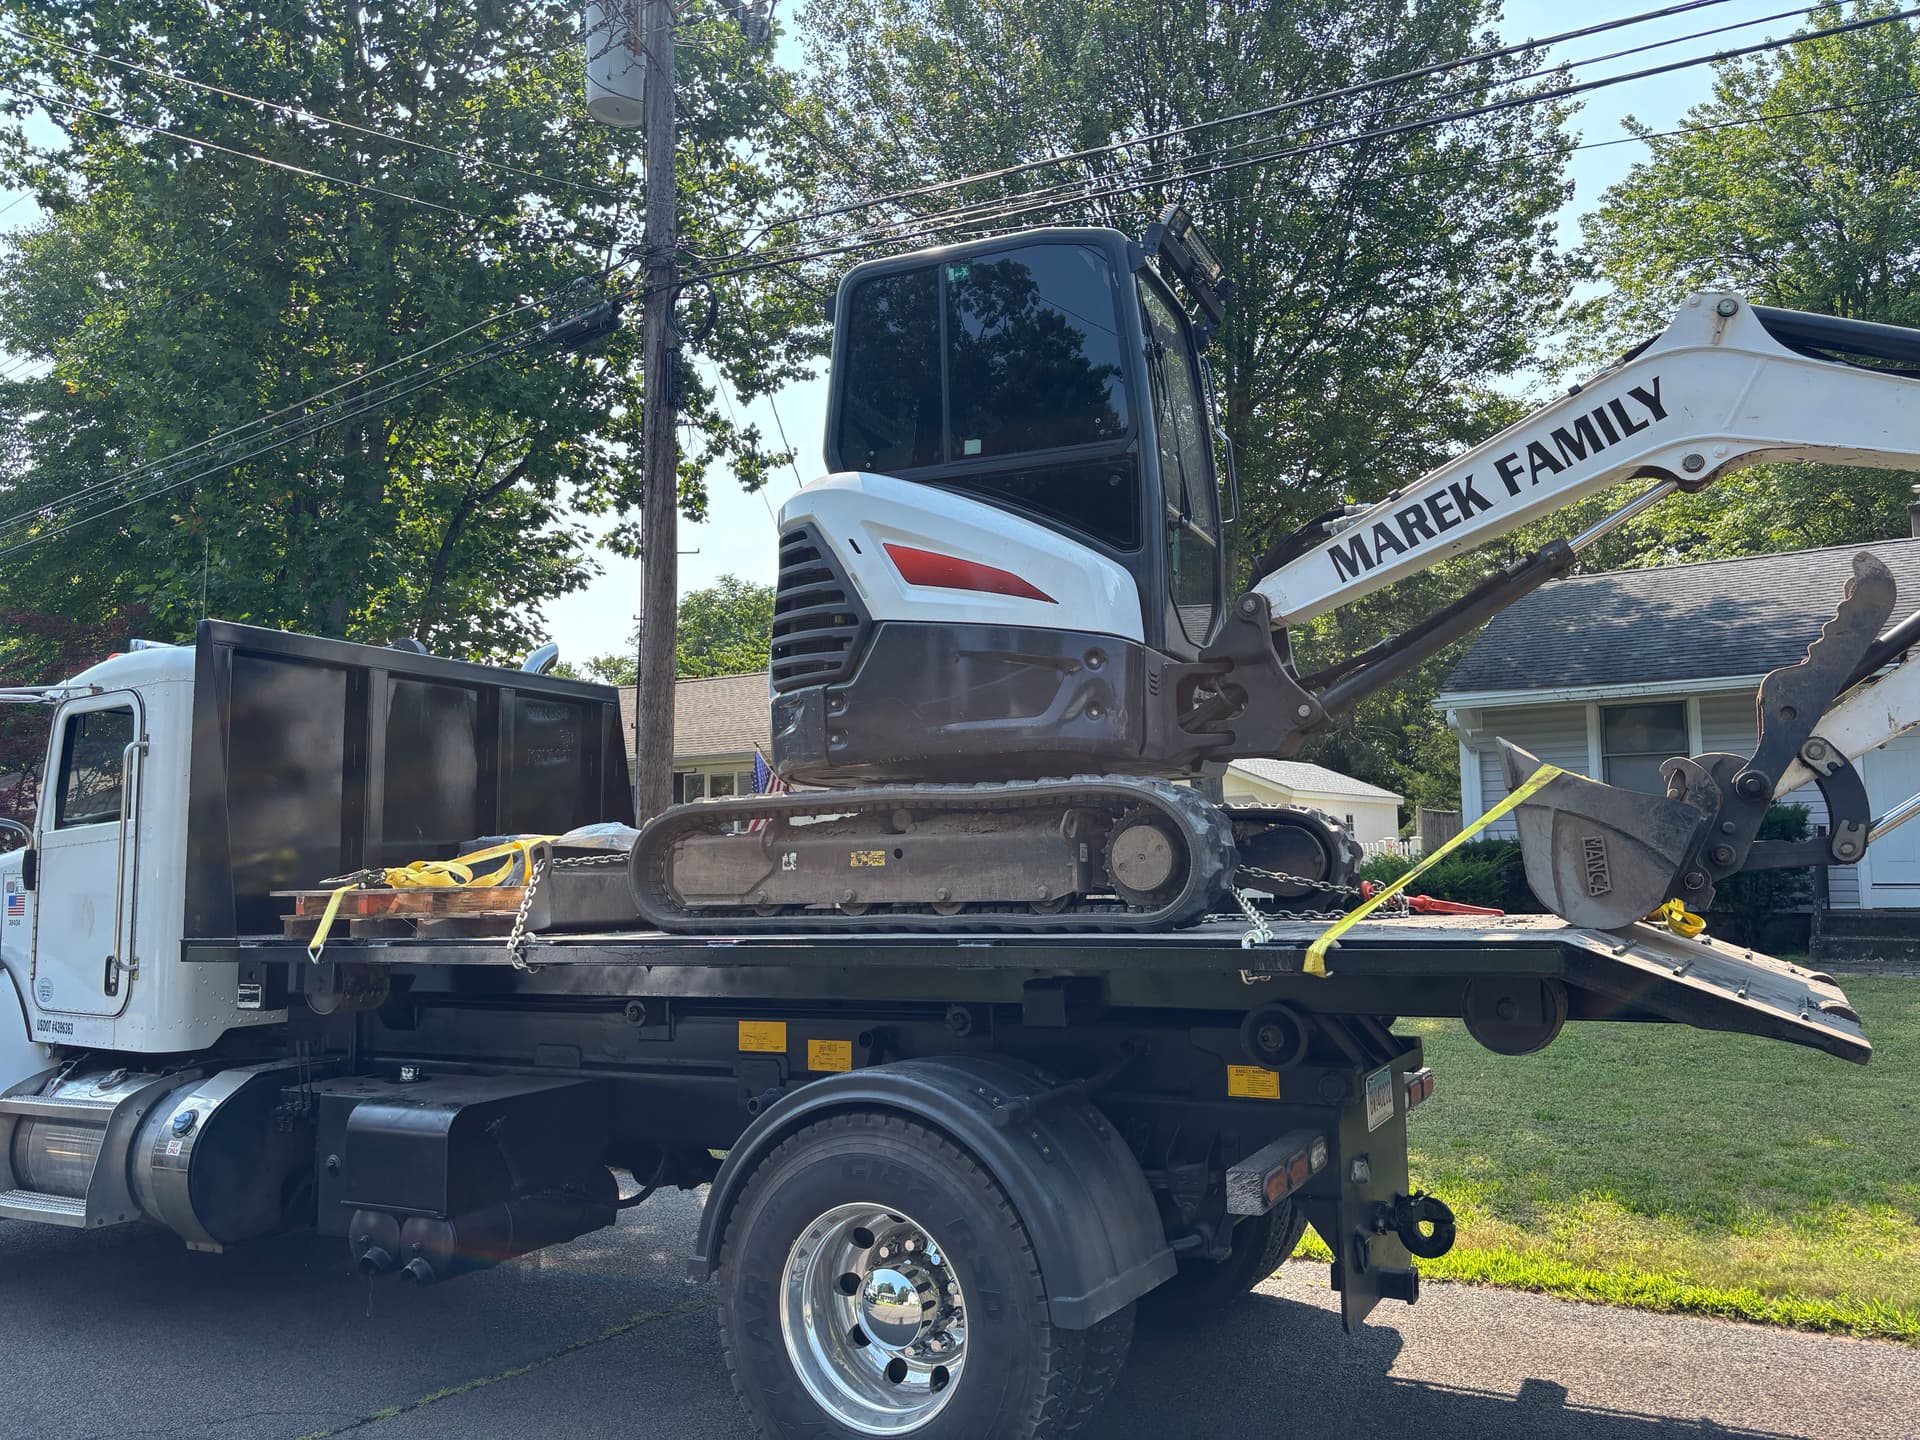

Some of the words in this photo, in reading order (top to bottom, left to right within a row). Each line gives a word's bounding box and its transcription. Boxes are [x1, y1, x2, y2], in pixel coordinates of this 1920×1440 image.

[1326, 474, 1494, 583] MAREK
[1494, 375, 1669, 497] FAMILY
[1583, 836, 1611, 896] MANCA
[37, 1019, 52, 1033] USDOT
